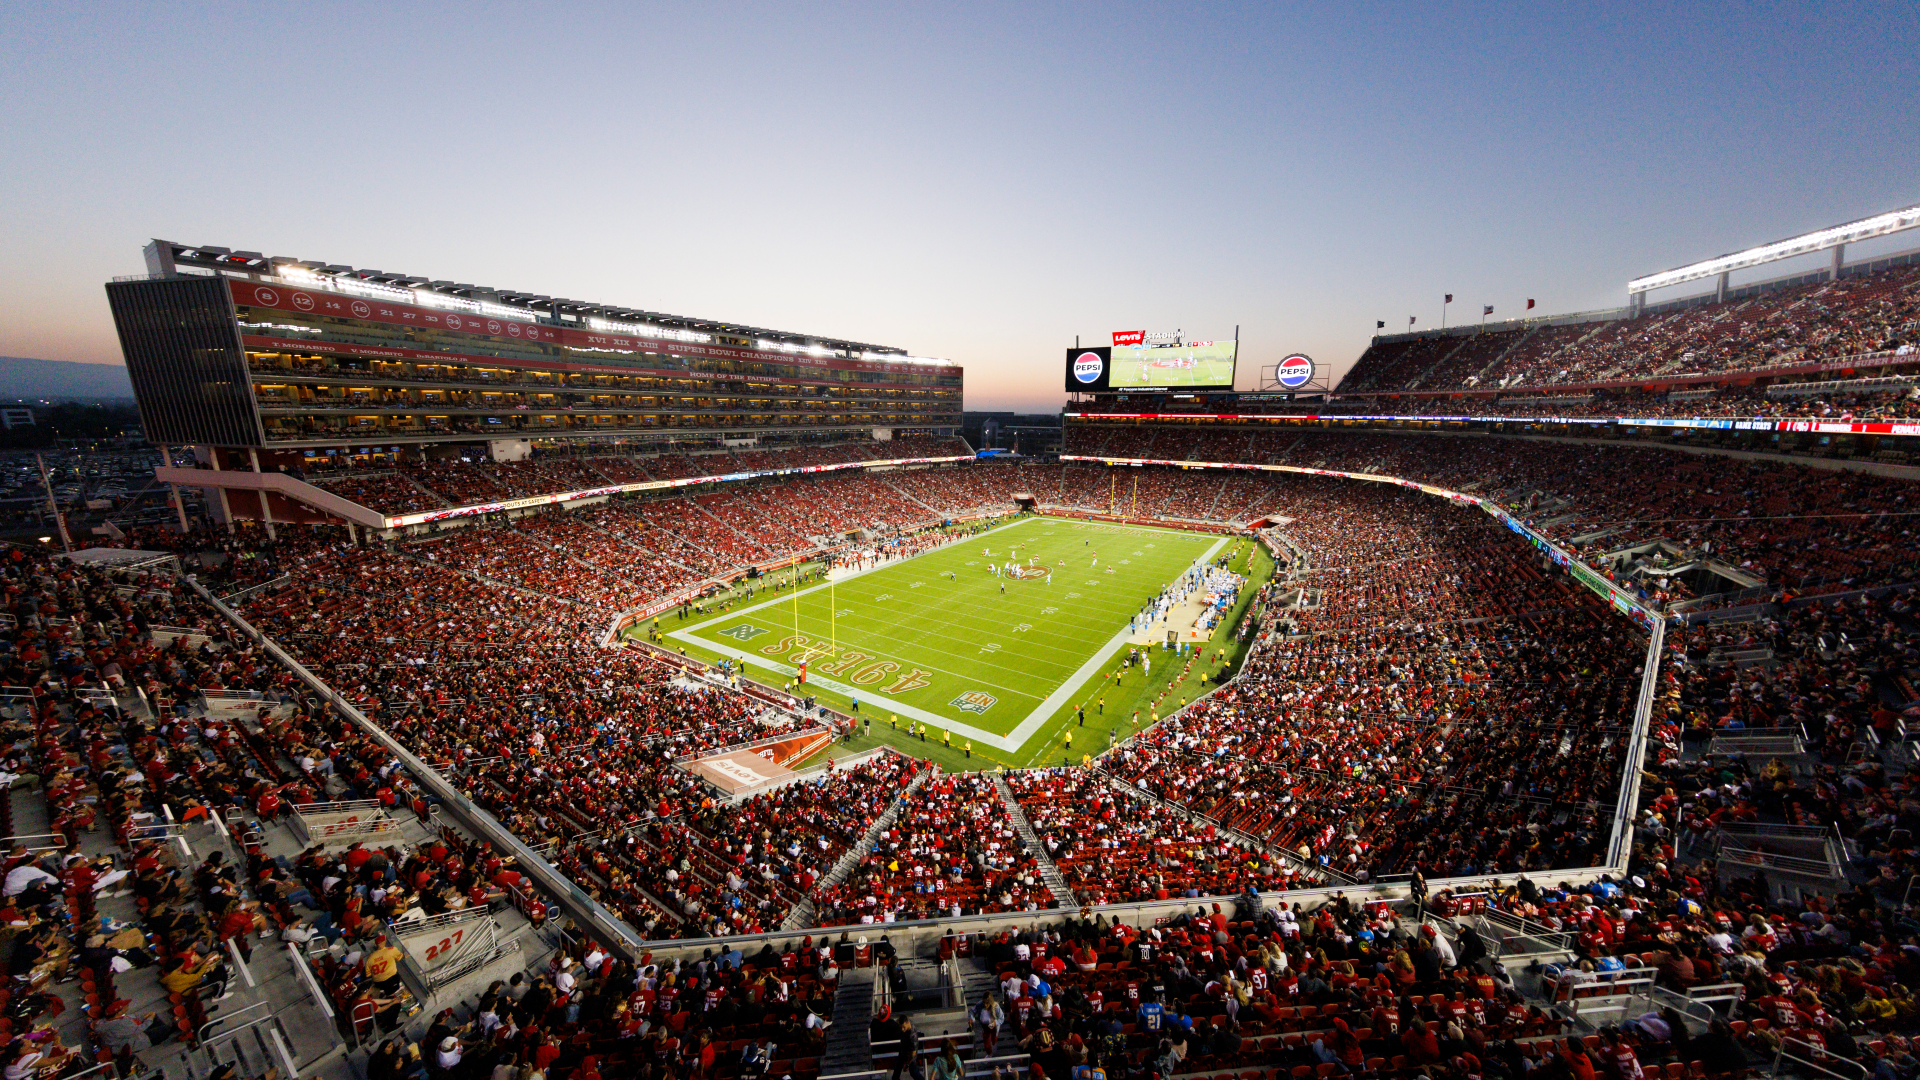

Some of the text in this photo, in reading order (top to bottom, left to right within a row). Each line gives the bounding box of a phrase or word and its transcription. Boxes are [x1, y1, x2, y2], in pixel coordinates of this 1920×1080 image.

[1146, 331, 1185, 340] STADIUM
[282, 342, 336, 352] MORABITO
[359, 349, 403, 357] MORABITO
[588, 336, 606, 344] XVI
[613, 338, 630, 346] XIX
[637, 341, 658, 349] XXIII
[667, 344, 706, 354] SUPER
[708, 348, 738, 357] BOWL
[740, 351, 794, 362] CHAMPIONS
[689, 371, 714, 379] HOME
[747, 375, 782, 383] FAITHFUL
[1280, 367, 1309, 375] PEPSI
[1735, 421, 1772, 430] GAME STATS
[645, 598, 676, 616] FAITHFUL
[690, 588, 701, 598] BAY
[759, 635, 934, 695] 49ERS
[964, 692, 993, 707] NFL
[425, 929, 463, 961] 227
[371, 961, 388, 976] 97
[1252, 975, 1267, 990] 97
[633, 1001, 646, 1014] 97
[1147, 1014, 1161, 1030] 21
[1474, 1012, 1486, 1025] 97
[1776, 1008, 1797, 1024] 85
[1617, 1059, 1643, 1079] 54
